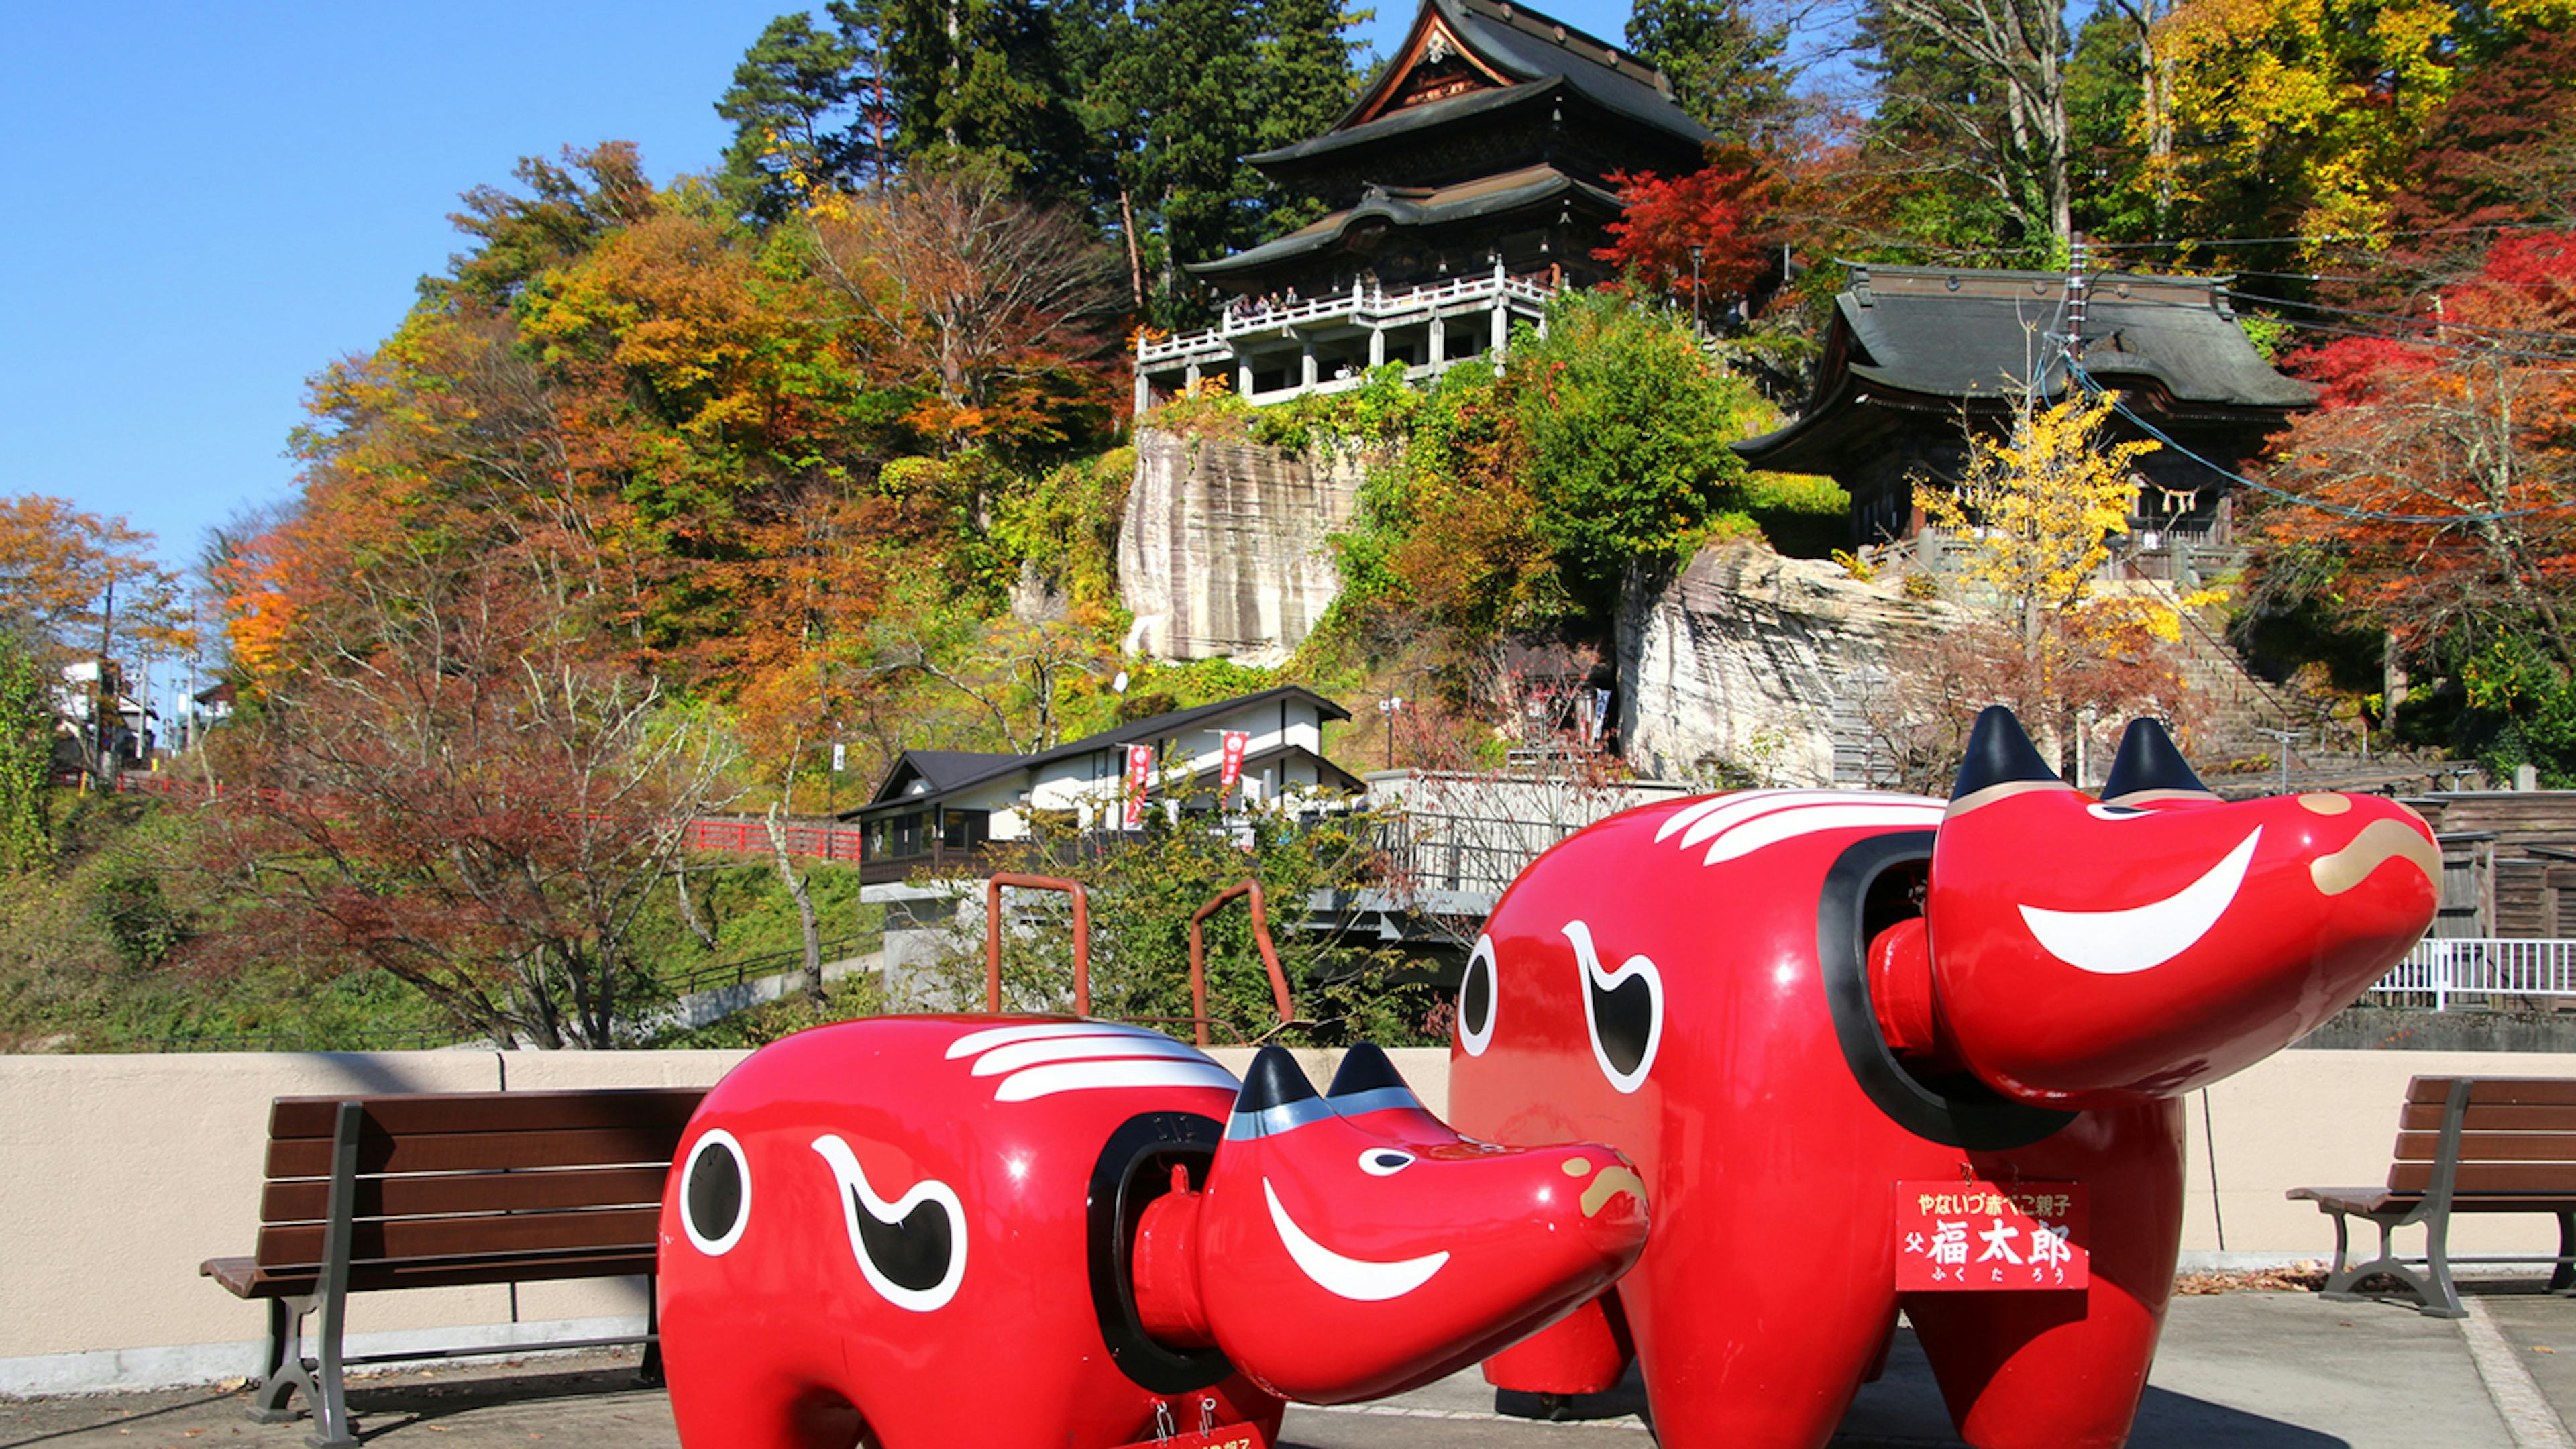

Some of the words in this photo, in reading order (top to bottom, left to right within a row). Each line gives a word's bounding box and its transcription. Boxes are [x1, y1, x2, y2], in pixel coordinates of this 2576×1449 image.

[1918, 1192, 2071, 1216] やないづ赤べこ親子
[1904, 1232, 1925, 1253] 父
[1925, 1218, 2071, 1269] 福太郎
[1932, 1266, 2063, 1284] ふくたろう
